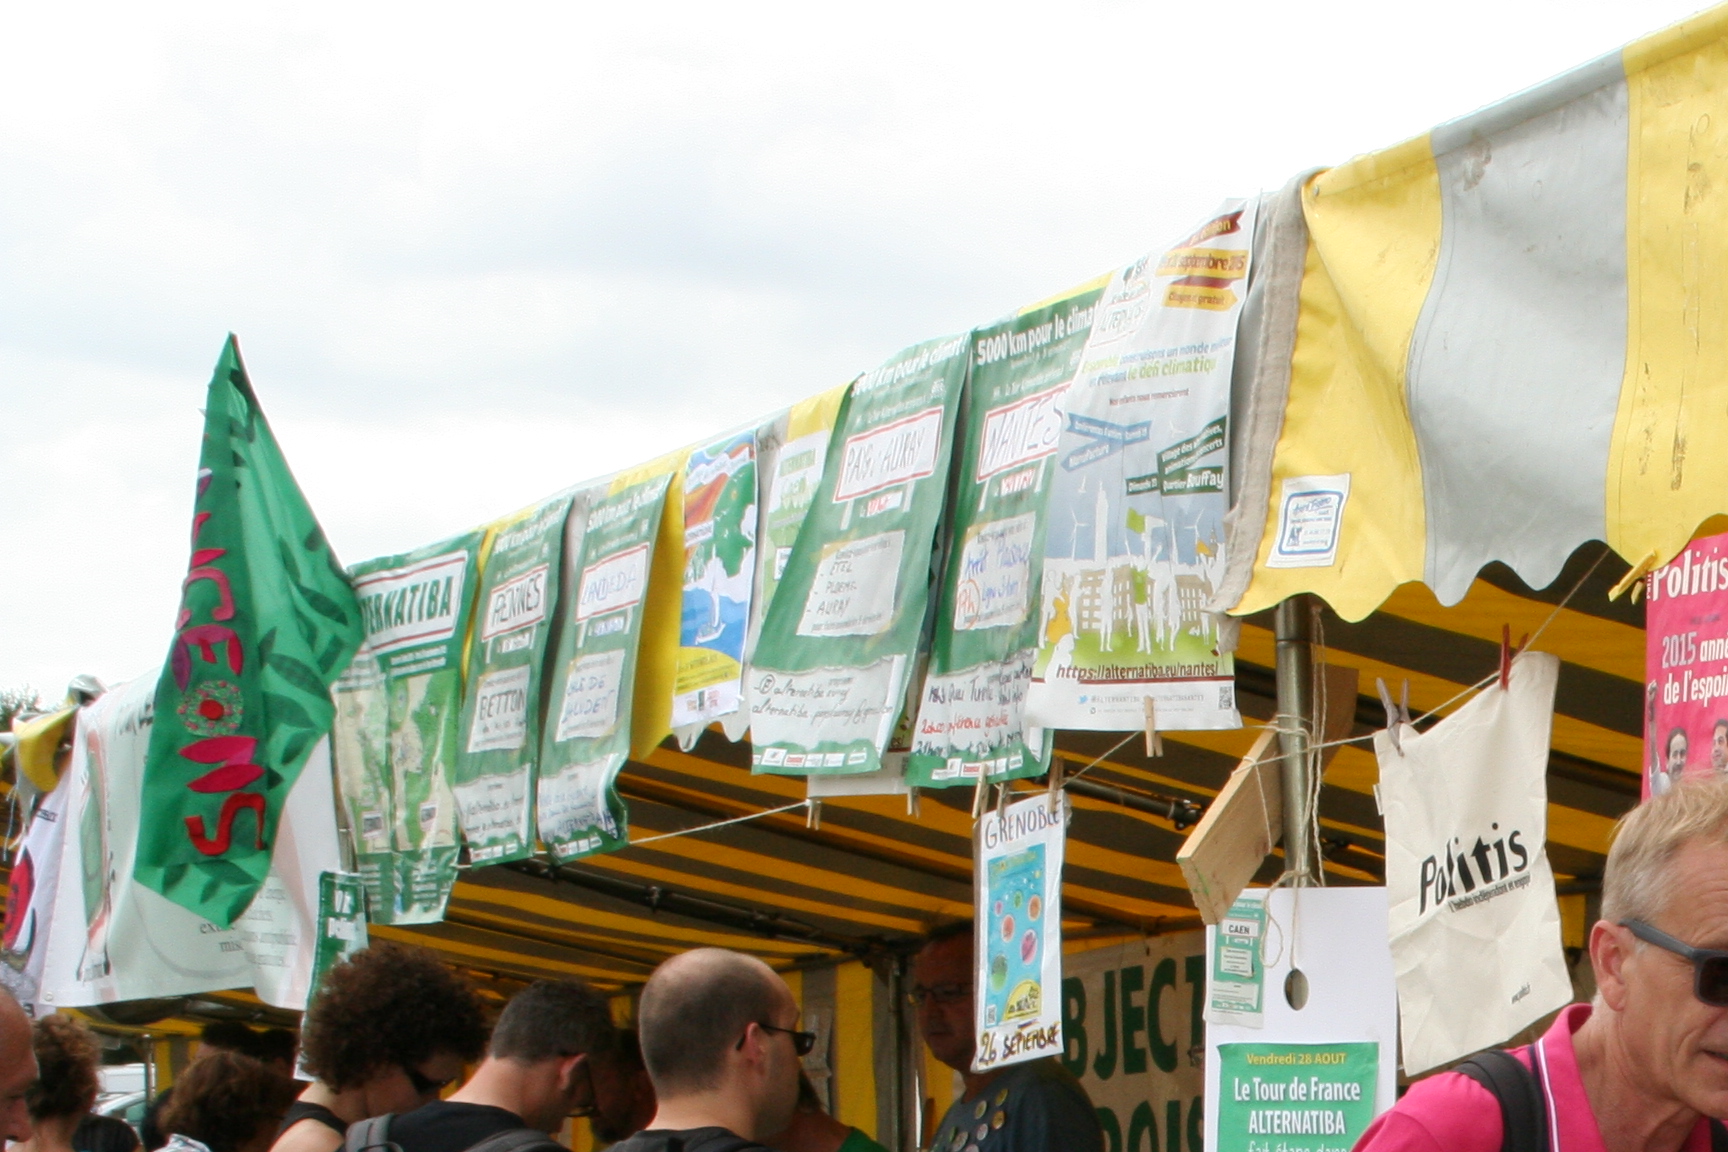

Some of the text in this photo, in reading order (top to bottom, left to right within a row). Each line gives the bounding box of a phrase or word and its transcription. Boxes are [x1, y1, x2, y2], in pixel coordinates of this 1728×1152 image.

[977, 331, 1008, 366] 5000
[1007, 329, 1028, 357] km
[1027, 321, 1053, 352] pour
[1053, 313, 1065, 340] le
[1661, 631, 1698, 670] 2015
[1055, 660, 1219, 681] https://alternatiba.eu/nantes/
[1663, 672, 1680, 705] de
[984, 801, 1062, 850] GRENOBLE
[1418, 821, 1529, 917] Politis
[1227, 923, 1251, 936] CAEN
[1246, 1052, 1348, 1066] Vendredi 28 AOUT
[1233, 1076, 1362, 1102] Le Tour de France
[1247, 1109, 1347, 1136] ALTERNATIBA
